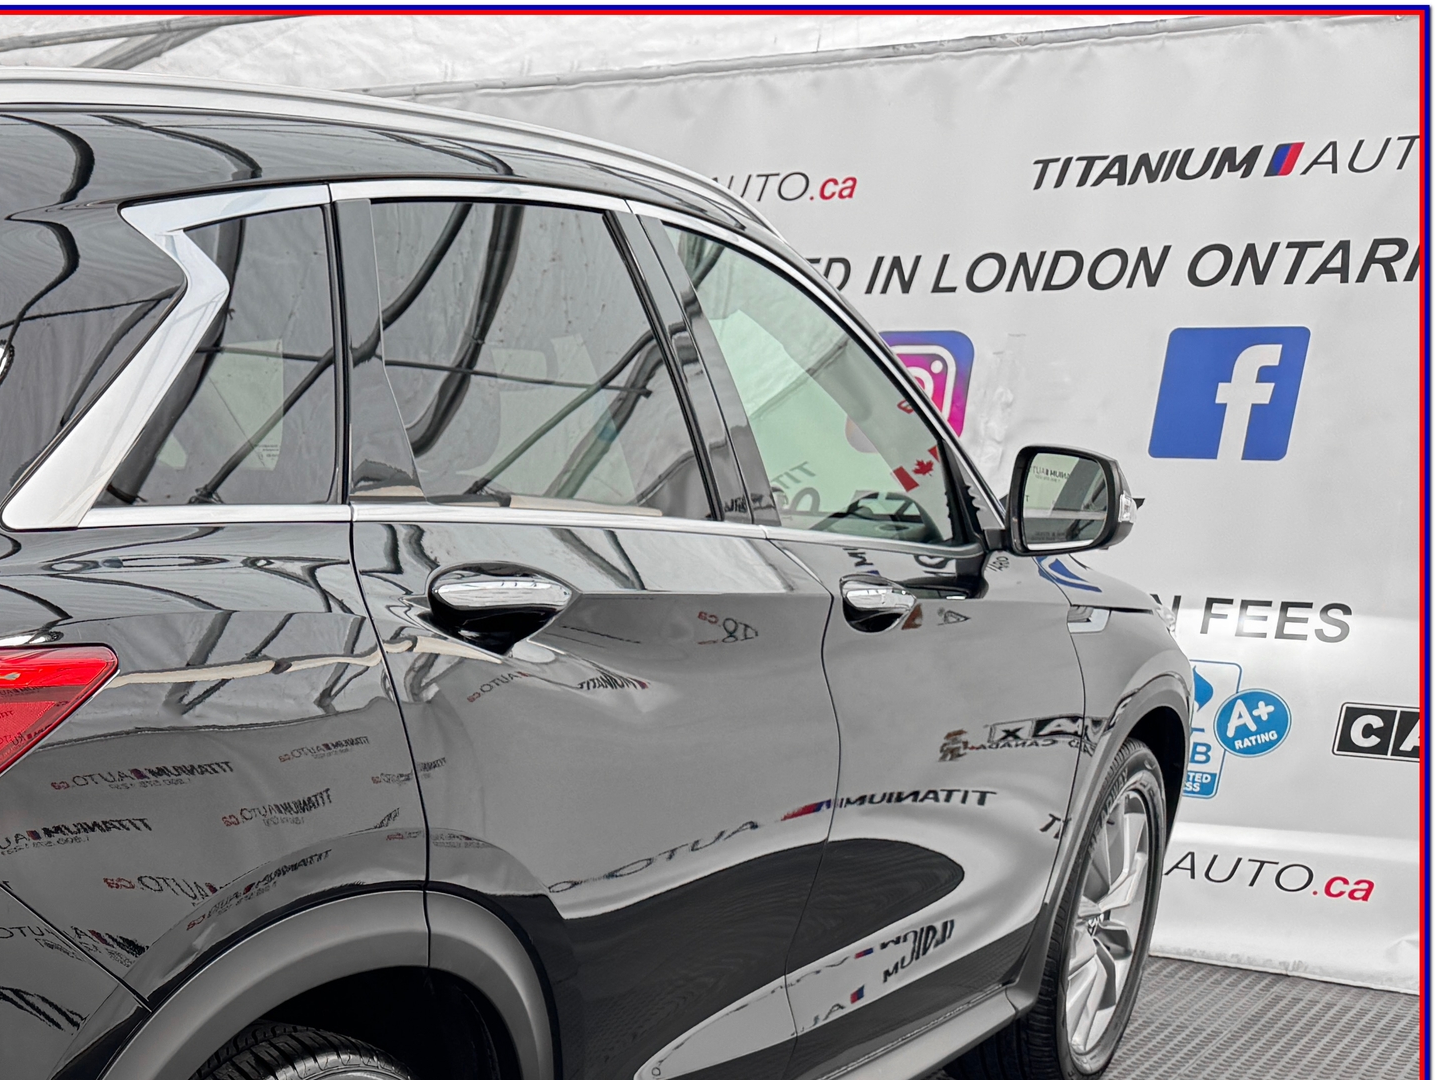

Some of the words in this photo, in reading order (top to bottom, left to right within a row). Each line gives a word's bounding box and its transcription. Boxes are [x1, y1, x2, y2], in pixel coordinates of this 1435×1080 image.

[1032, 144, 1264, 190] TITANIUM
[805, 256, 852, 292] D
[864, 255, 922, 295] IN
[930, 245, 1172, 294] LONDON
[1200, 597, 1353, 643] FEES
[1226, 699, 1275, 738] A+
[1234, 730, 1278, 750] RATING
[1183, 781, 1200, 792] SS
[1164, 851, 1375, 902] AUTO.ca
